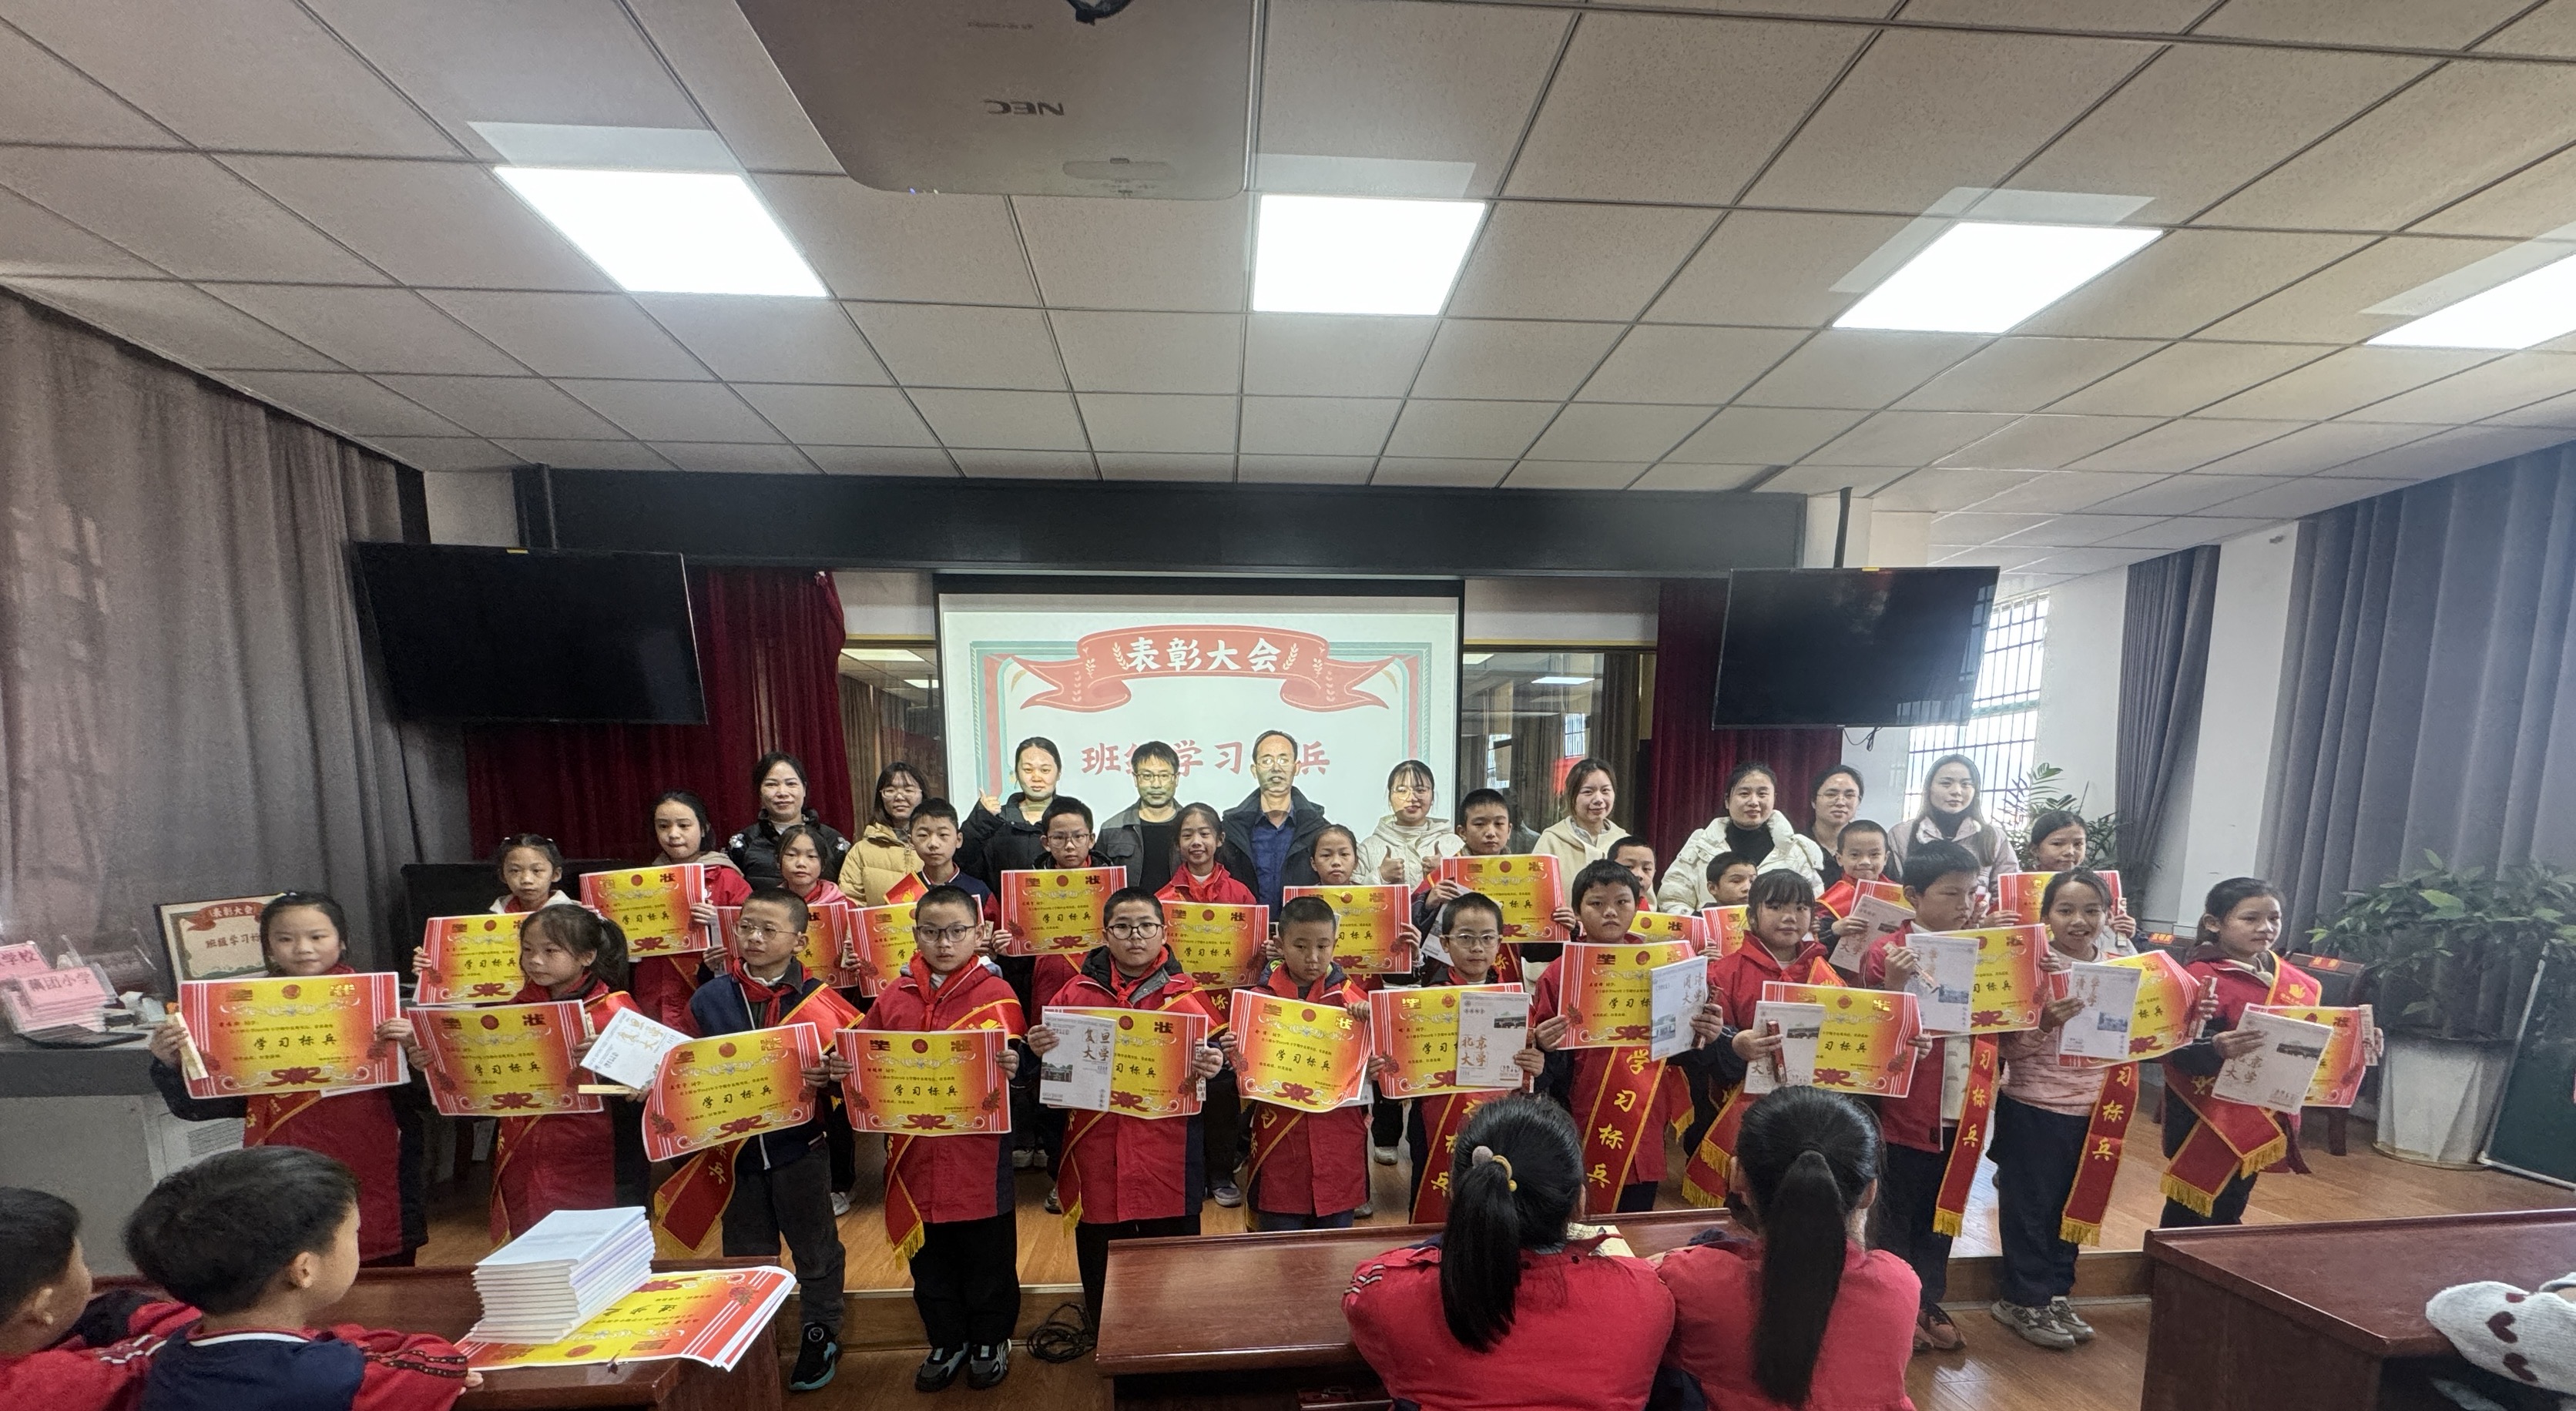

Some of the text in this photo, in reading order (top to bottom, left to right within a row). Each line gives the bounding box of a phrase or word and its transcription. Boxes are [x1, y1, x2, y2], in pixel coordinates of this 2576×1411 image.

[982, 98, 1064, 116] NEC
[1127, 636, 1281, 674] 表彰大会
[1081, 739, 1330, 778] 班学习兵
[622, 910, 670, 925] 学习标兵
[1042, 911, 1092, 923] 学习标兵
[1184, 946, 1233, 959] 学习标兵
[464, 958, 517, 970] 学习标兵
[253, 1033, 337, 1051] 学习标兵
[1825, 1041, 1868, 1054] 习标兵
[474, 1061, 542, 1077] 学习标兵
[1276, 1049, 1331, 1071] 学习标兵
[702, 1084, 773, 1109] 学习标兵
[894, 1084, 959, 1097] 学习标兵
[1962, 1048, 1992, 1148] 习标兵
[1586, 1048, 1651, 1189] 学习标兵
[2091, 1064, 2132, 1162] 习标兵
